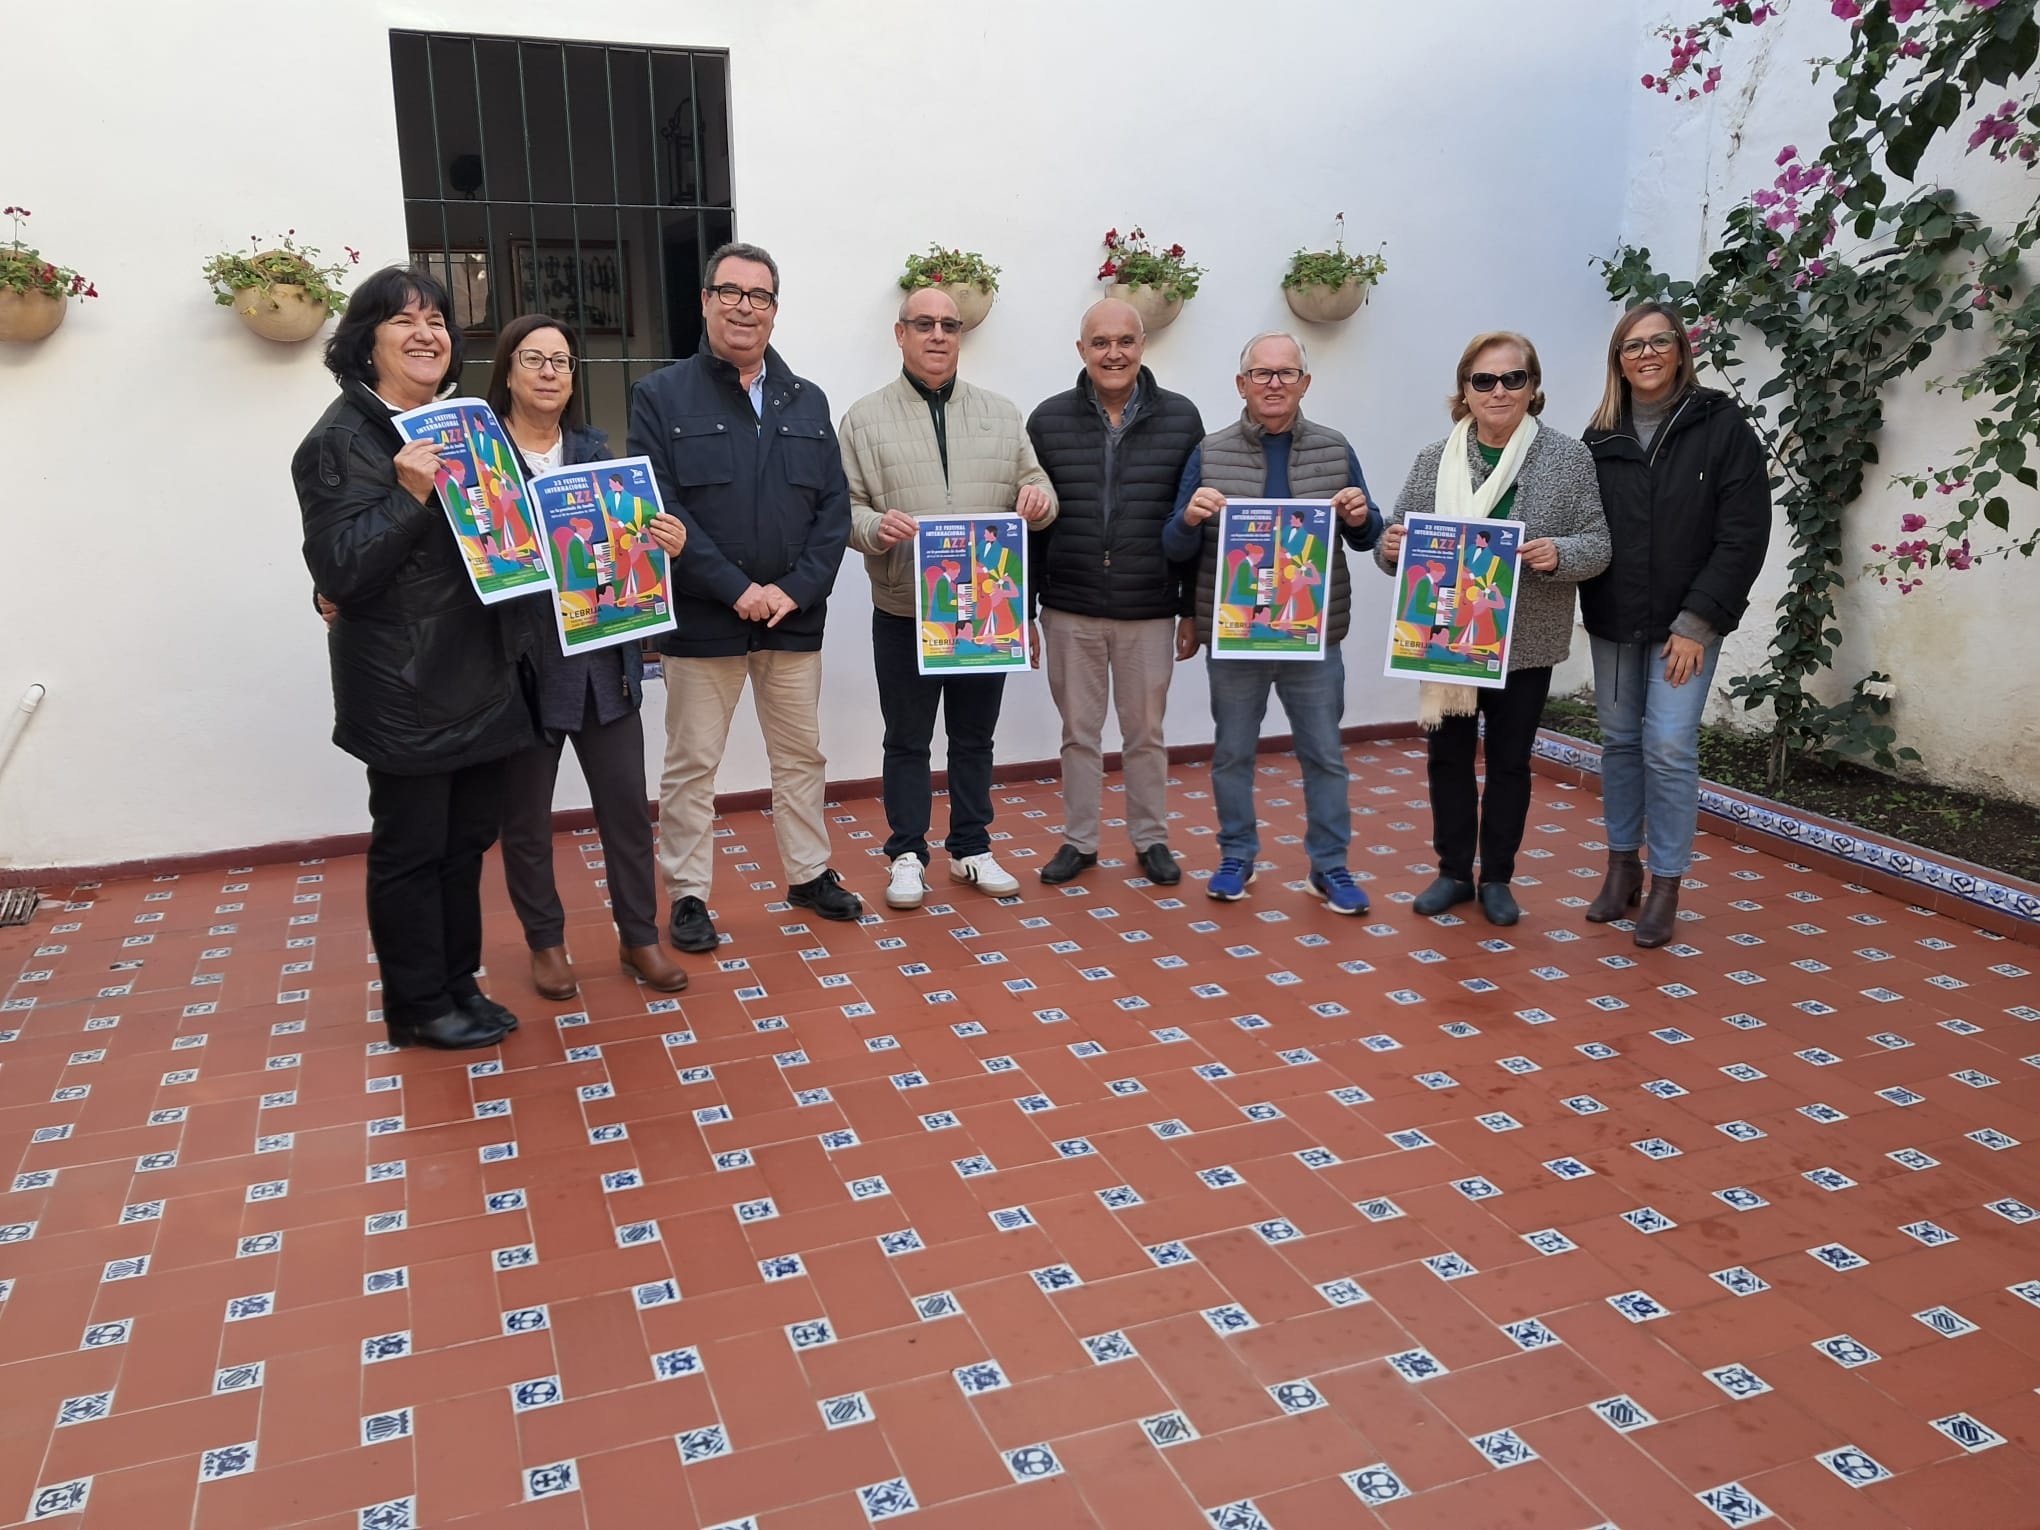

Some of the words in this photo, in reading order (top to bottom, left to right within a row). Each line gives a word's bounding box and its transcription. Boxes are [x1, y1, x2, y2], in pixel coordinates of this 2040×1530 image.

[434, 413, 457, 421] FESTIVAL
[416, 420, 459, 434] INTERNACIONAL
[563, 477, 587, 485] FESTIVAL
[544, 483, 589, 494] INTERNACIONAL
[561, 490, 592, 506] JAZZ
[1244, 522, 1271, 533] JAZZ
[1414, 529, 1456, 538] INTERNACIONAL
[939, 538, 966, 549] JAZZ
[1426, 538, 1455, 550] JAZZ
[569, 606, 602, 619] LEBRIJA
[1399, 640, 1432, 649] LEBRIJA
